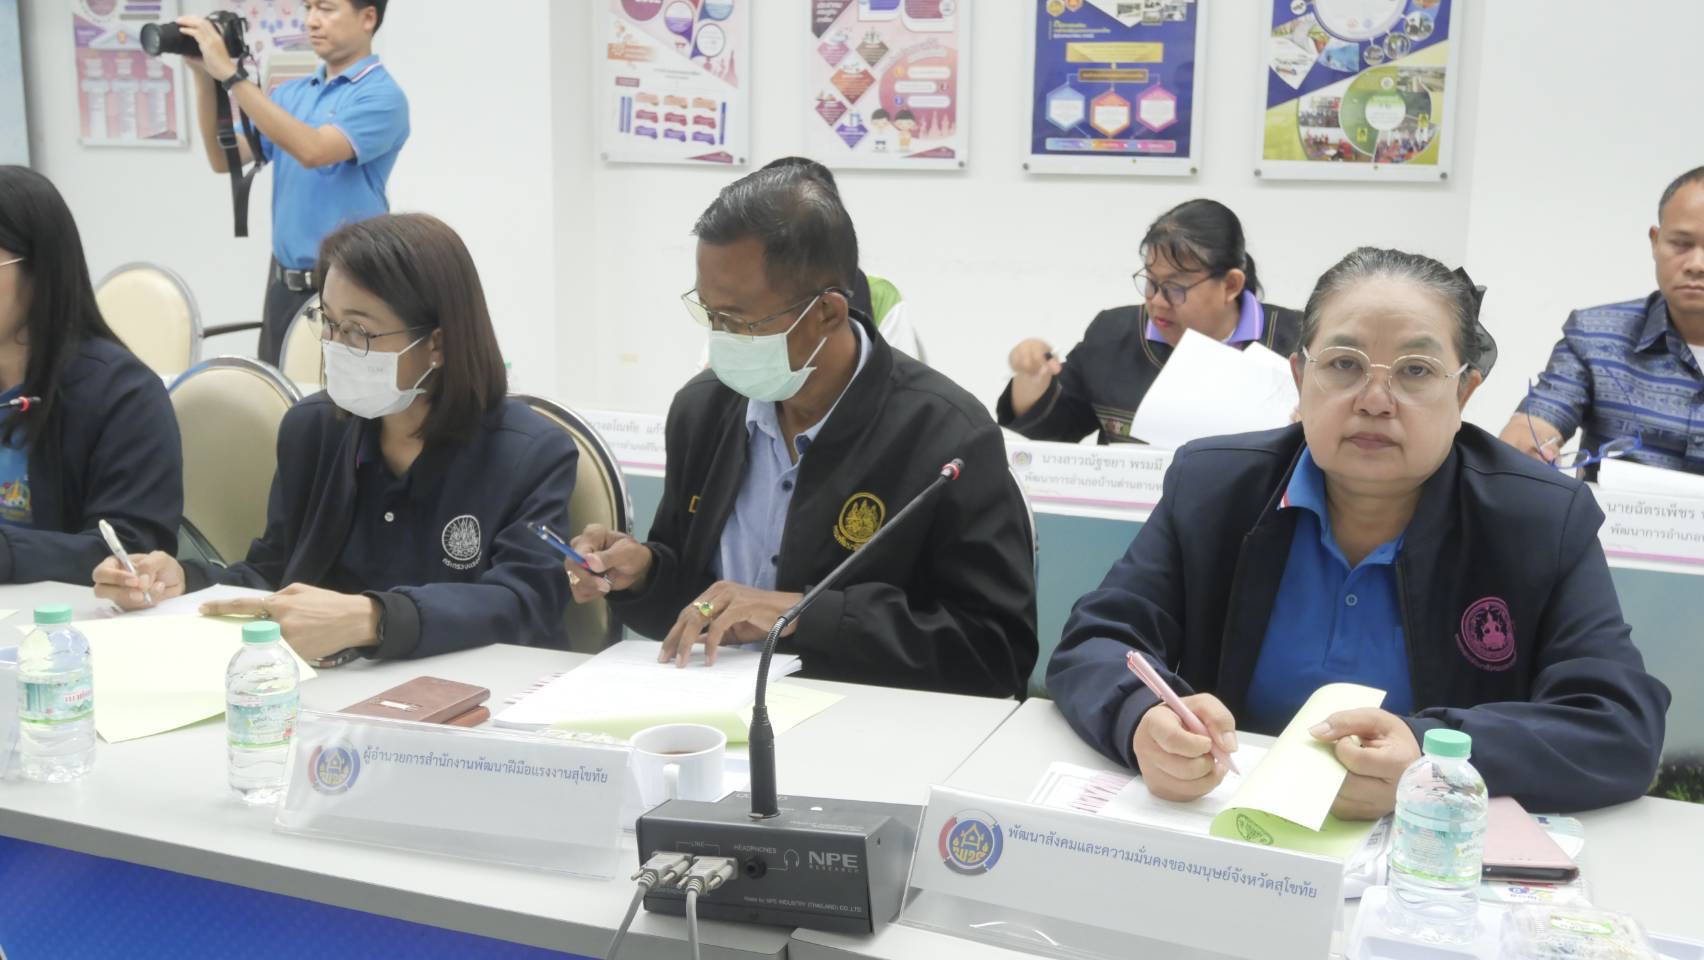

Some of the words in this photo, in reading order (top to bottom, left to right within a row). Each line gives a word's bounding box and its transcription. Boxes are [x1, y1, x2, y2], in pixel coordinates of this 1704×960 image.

[362, 745, 609, 785] ผู้อำนวยการสำนักงานพัฒนาฝีมือแรงงานสุโขทัย
[808, 850, 859, 869] NPE
[1007, 824, 1319, 898] พัฒนาสังคมและความมั่นคงของมนุษย์จังหวัดสุโขทัย
